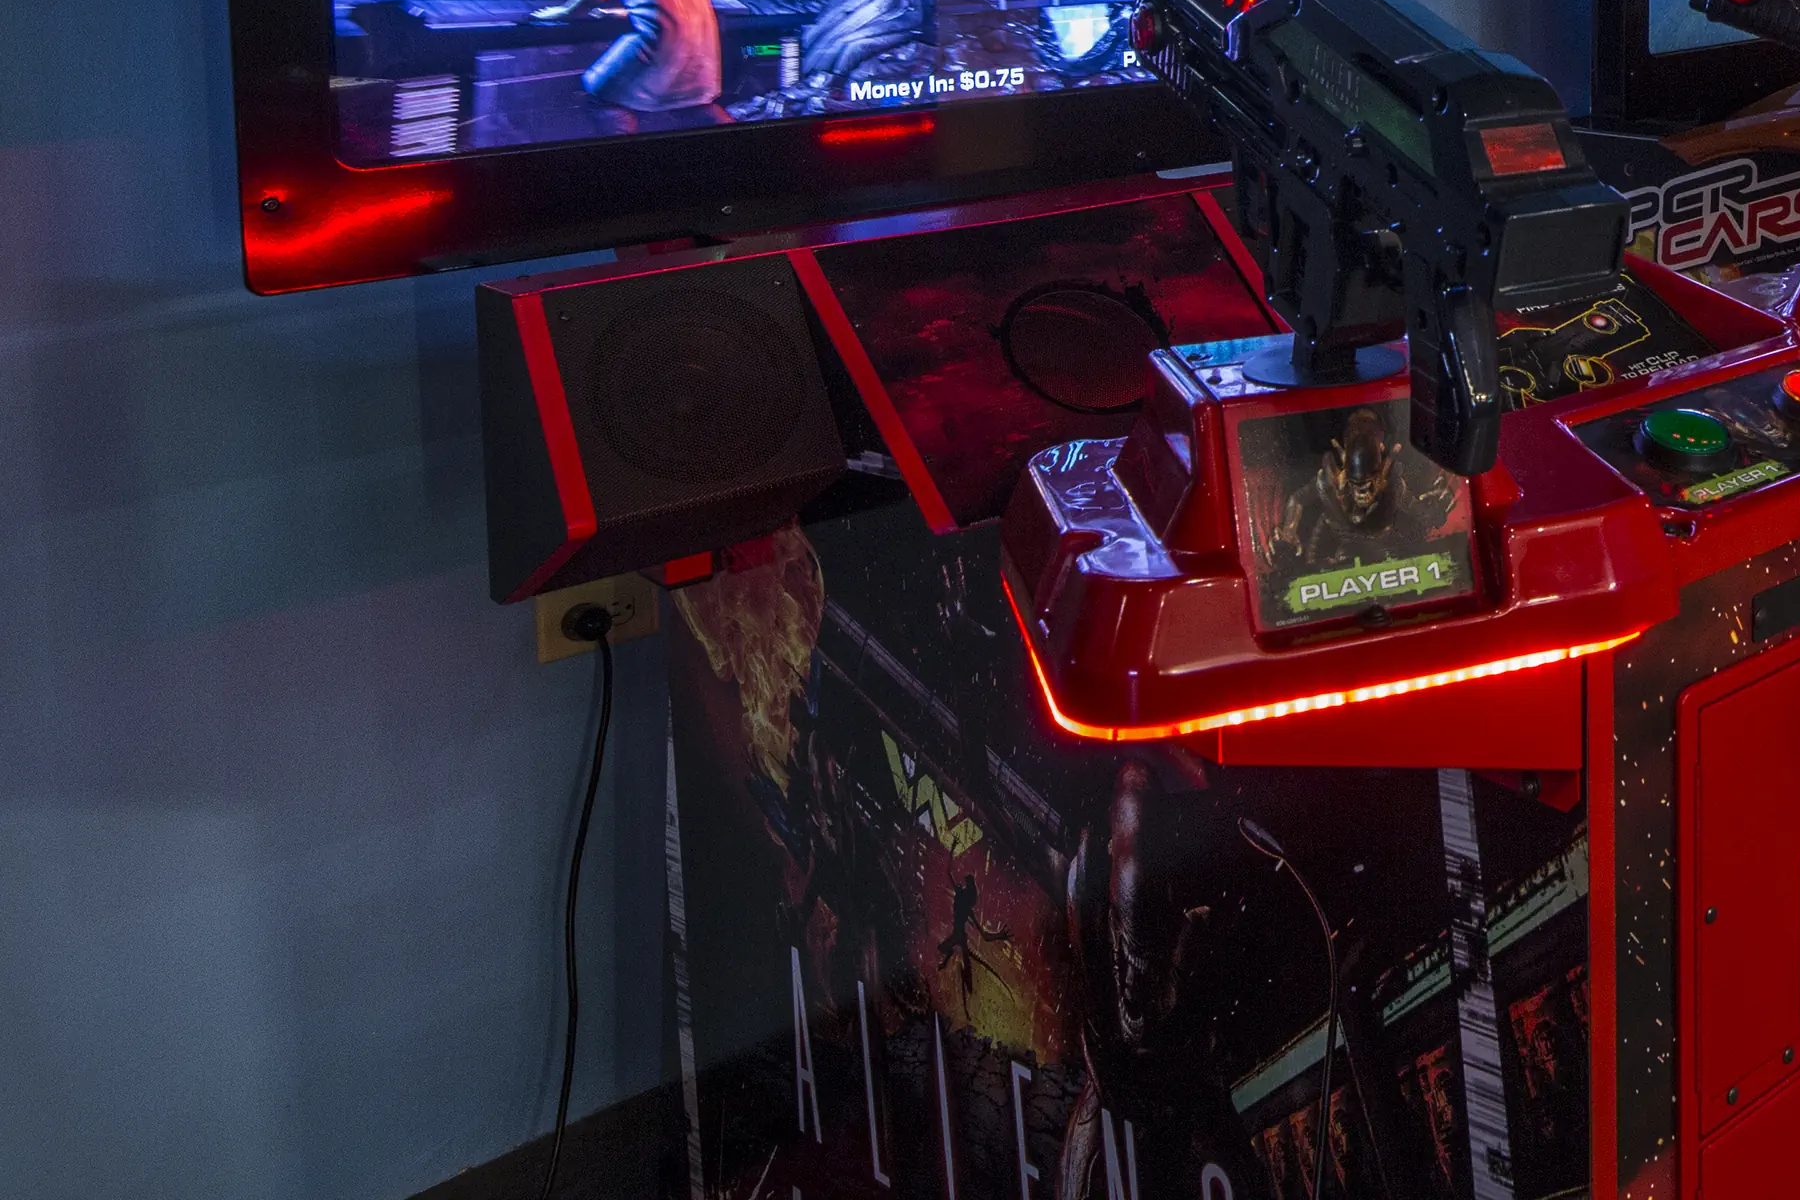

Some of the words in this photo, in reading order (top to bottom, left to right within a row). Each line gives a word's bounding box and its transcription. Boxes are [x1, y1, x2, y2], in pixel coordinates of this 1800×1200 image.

[850, 81, 924, 101] Money
[929, 76, 955, 94] In:
[960, 68, 1025, 92] $0.75
[1621, 372, 1638, 380] TO
[1628, 362, 1645, 371] HIT
[1645, 351, 1679, 366] CLIP
[1692, 469, 1764, 499] PLAYER
[1765, 464, 1781, 478] 1
[1299, 568, 1421, 604] PLAYER
[1425, 562, 1441, 585] 1
